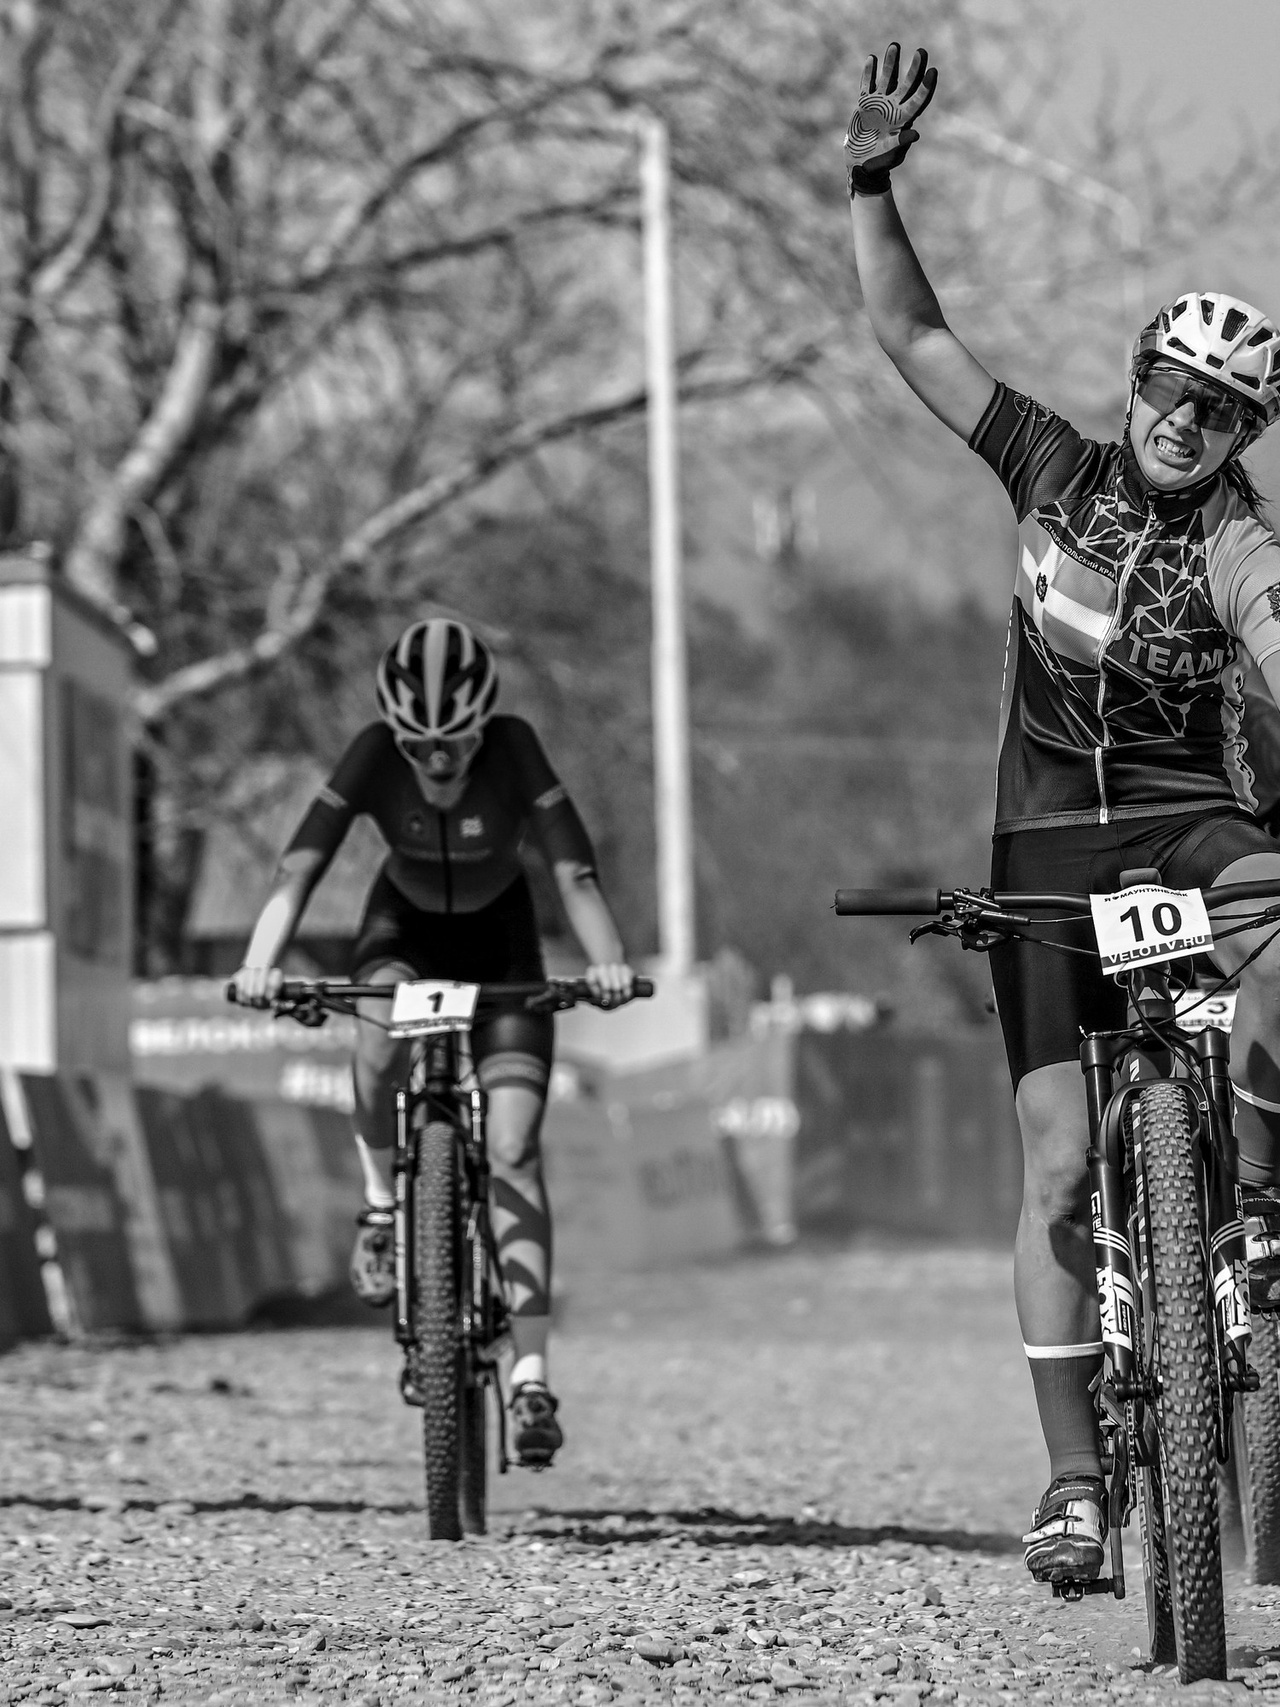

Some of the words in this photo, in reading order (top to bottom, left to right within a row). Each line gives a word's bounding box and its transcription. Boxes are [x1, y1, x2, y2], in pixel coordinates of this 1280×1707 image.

[1043, 521, 1099, 570] СТАВРОПОЛЬСКИЙ
[1128, 631, 1225, 678] TEAM
[1119, 902, 1182, 943] 10
[1108, 935, 1206, 964] VELOTV.RU
[427, 991, 444, 1014] 1
